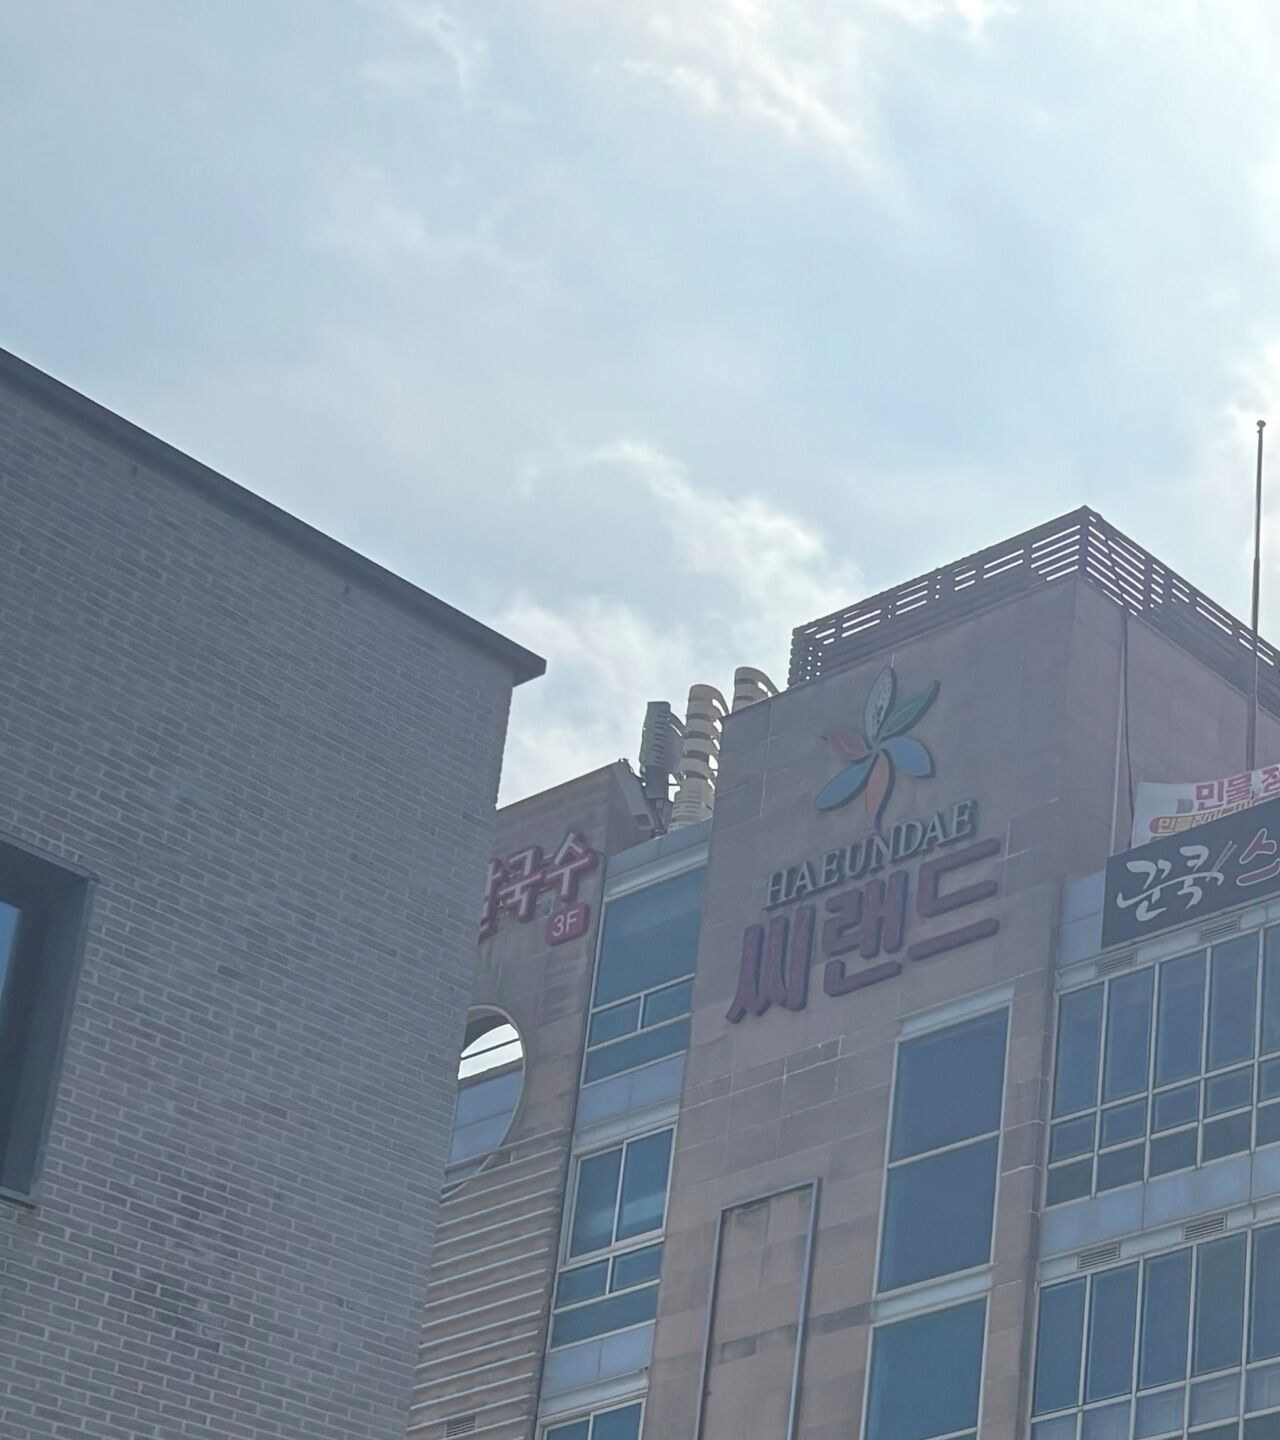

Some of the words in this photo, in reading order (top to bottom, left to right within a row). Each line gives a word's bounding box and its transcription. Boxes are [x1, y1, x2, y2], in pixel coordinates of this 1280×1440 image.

[763, 800, 980, 911] HAEUNDAE
[551, 908, 580, 938] 3F
[725, 837, 1001, 1024] 씨랜드
